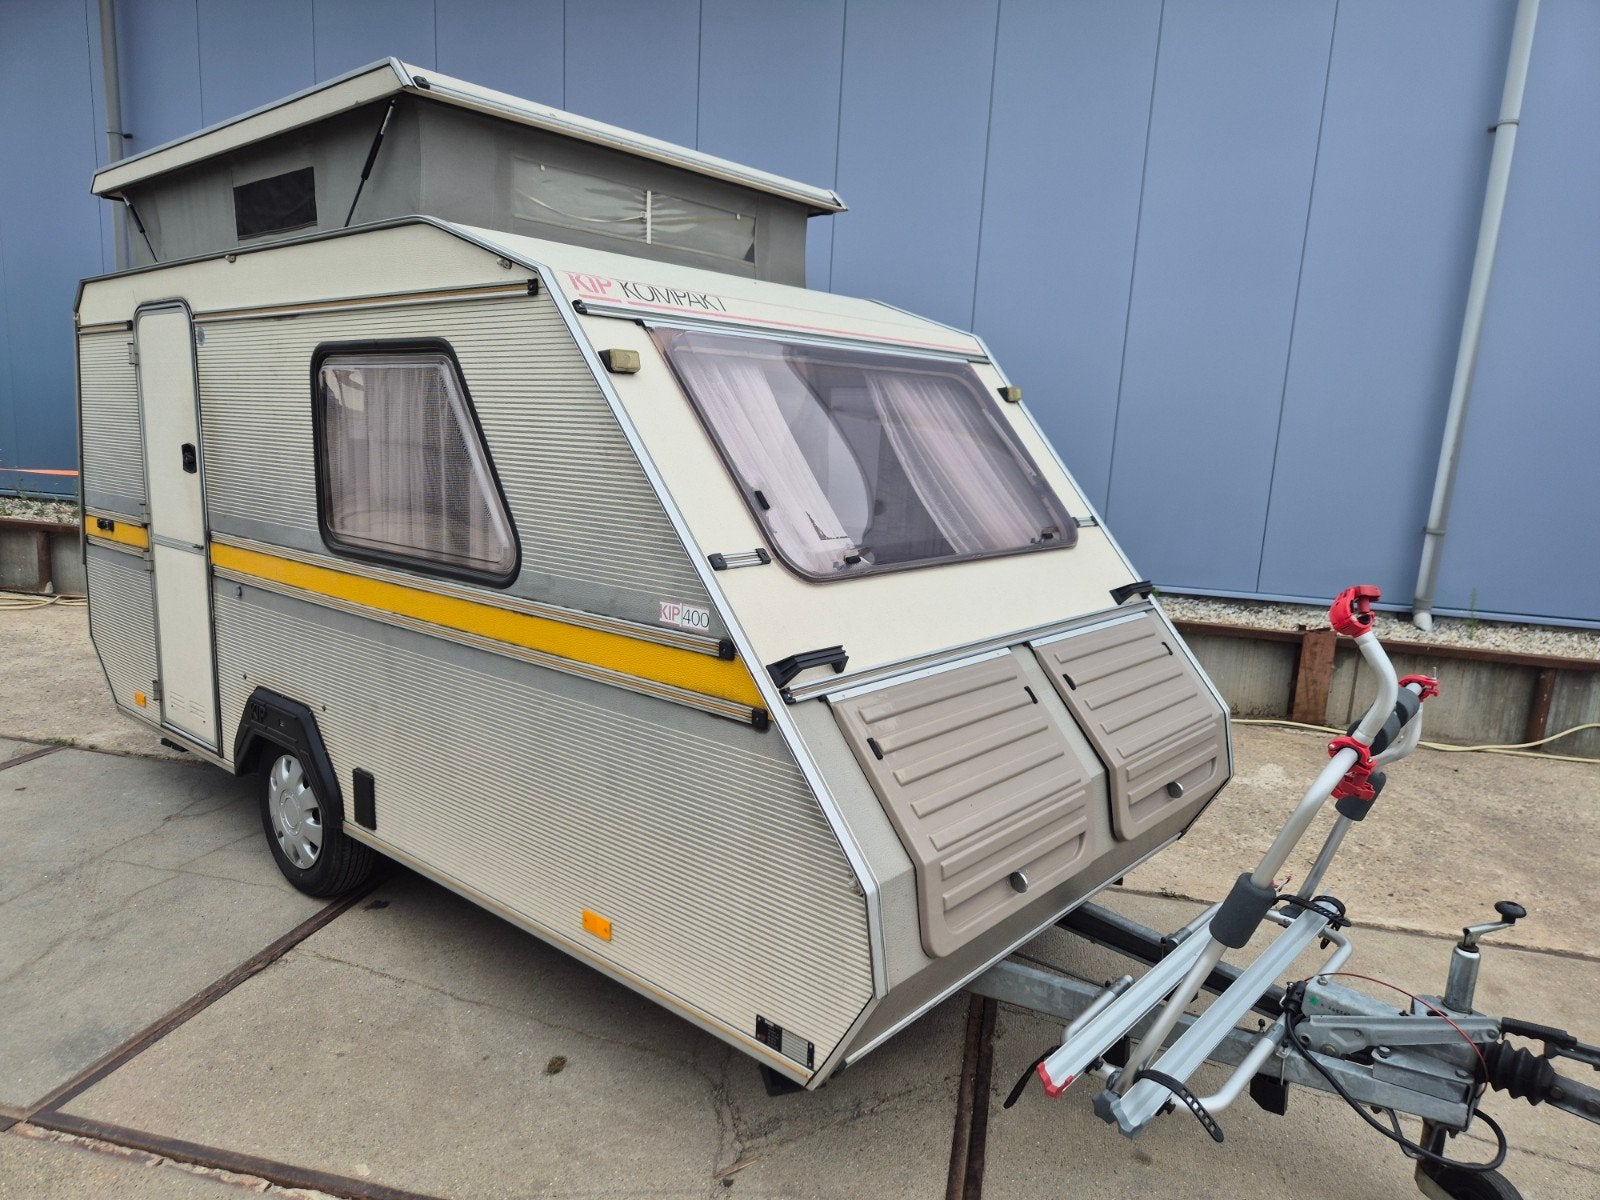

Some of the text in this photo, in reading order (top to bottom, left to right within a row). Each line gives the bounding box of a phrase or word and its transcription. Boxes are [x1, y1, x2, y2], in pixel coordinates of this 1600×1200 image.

[565, 271, 726, 312] KIP KOMPAKT
[657, 604, 710, 628] KIP 400
